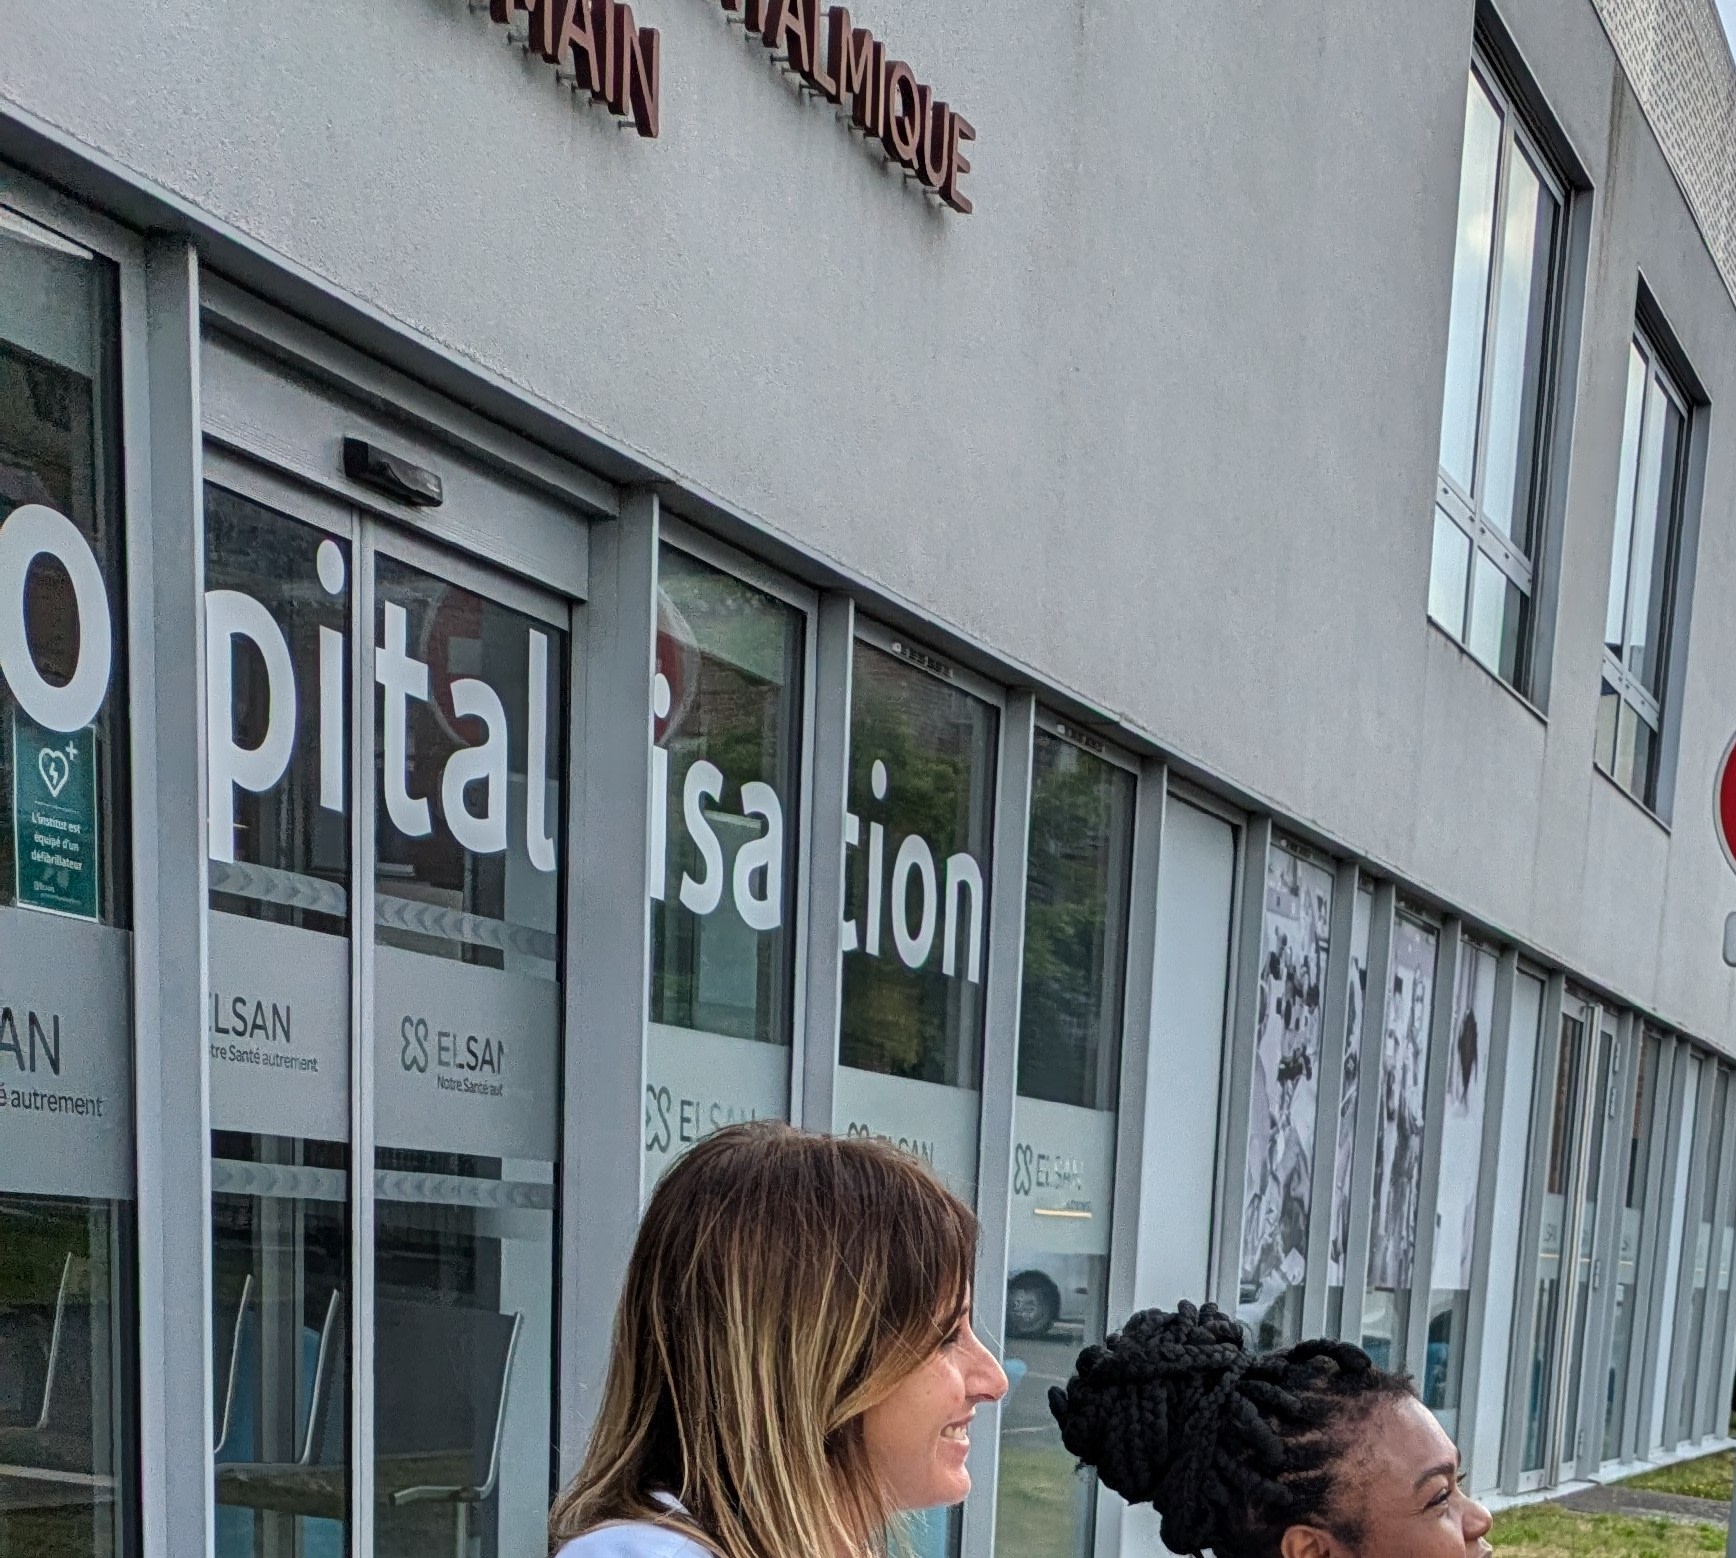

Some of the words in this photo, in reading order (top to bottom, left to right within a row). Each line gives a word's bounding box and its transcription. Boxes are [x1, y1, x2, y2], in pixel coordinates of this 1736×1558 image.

[722, 0, 976, 214] ALMIQUE
[209, 992, 291, 1043] LSAN
[229, 1044, 260, 1065] Santé
[10, 1090, 103, 1119] autrement
